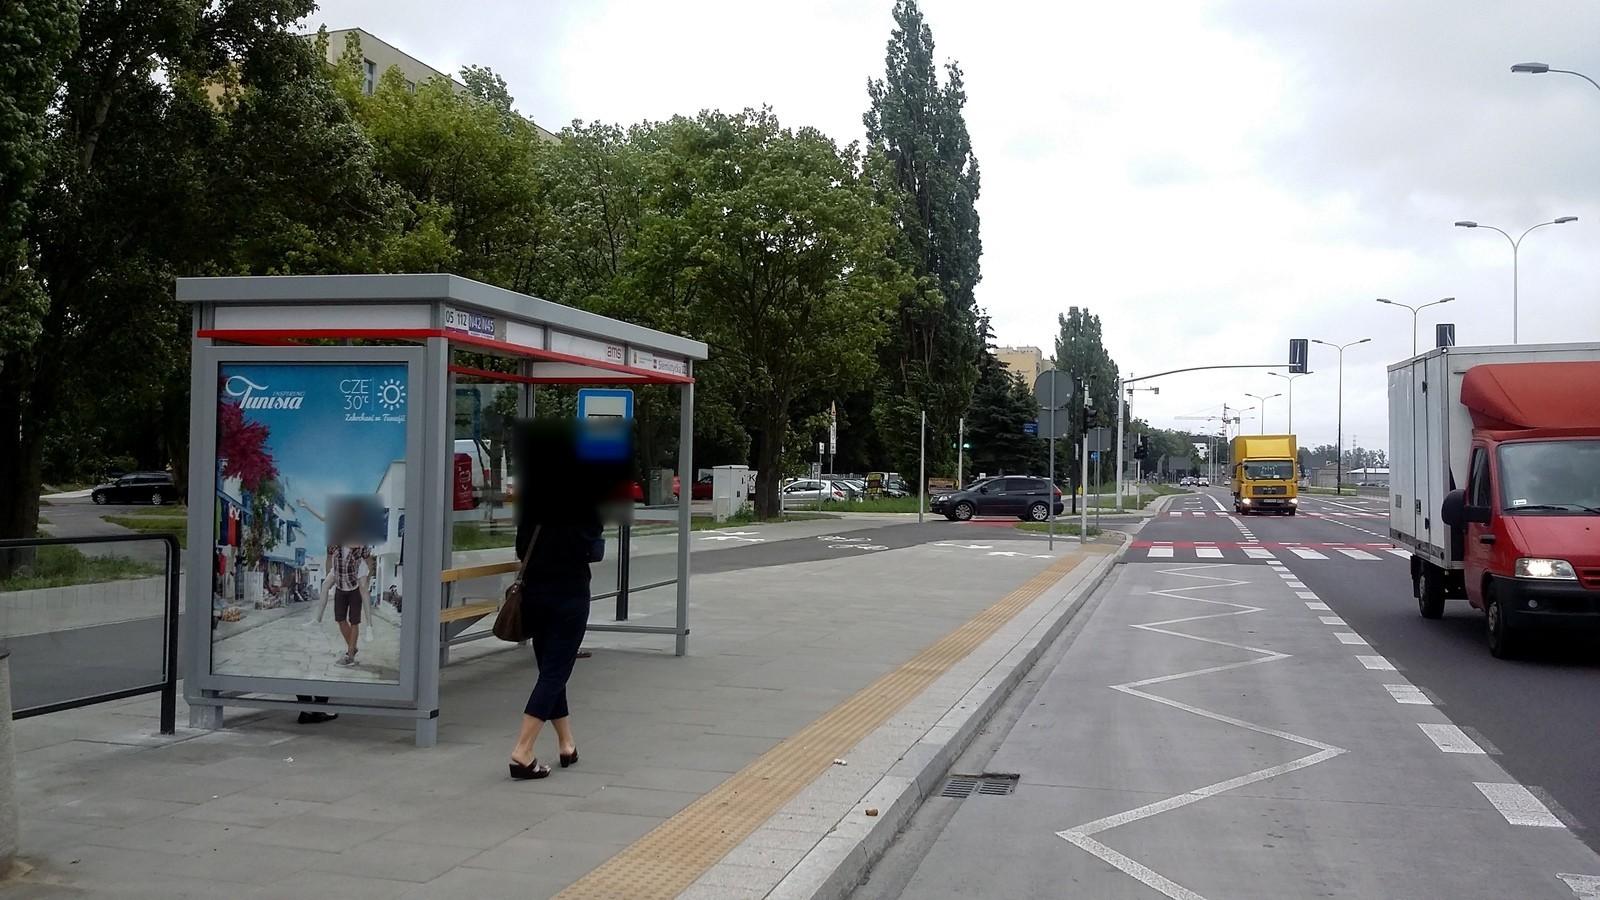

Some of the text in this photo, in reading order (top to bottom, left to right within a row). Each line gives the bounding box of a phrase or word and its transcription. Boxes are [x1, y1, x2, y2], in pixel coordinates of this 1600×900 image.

[457, 313, 467, 327] 112
[607, 346, 622, 360] ams
[225, 375, 305, 410] Tunisia
